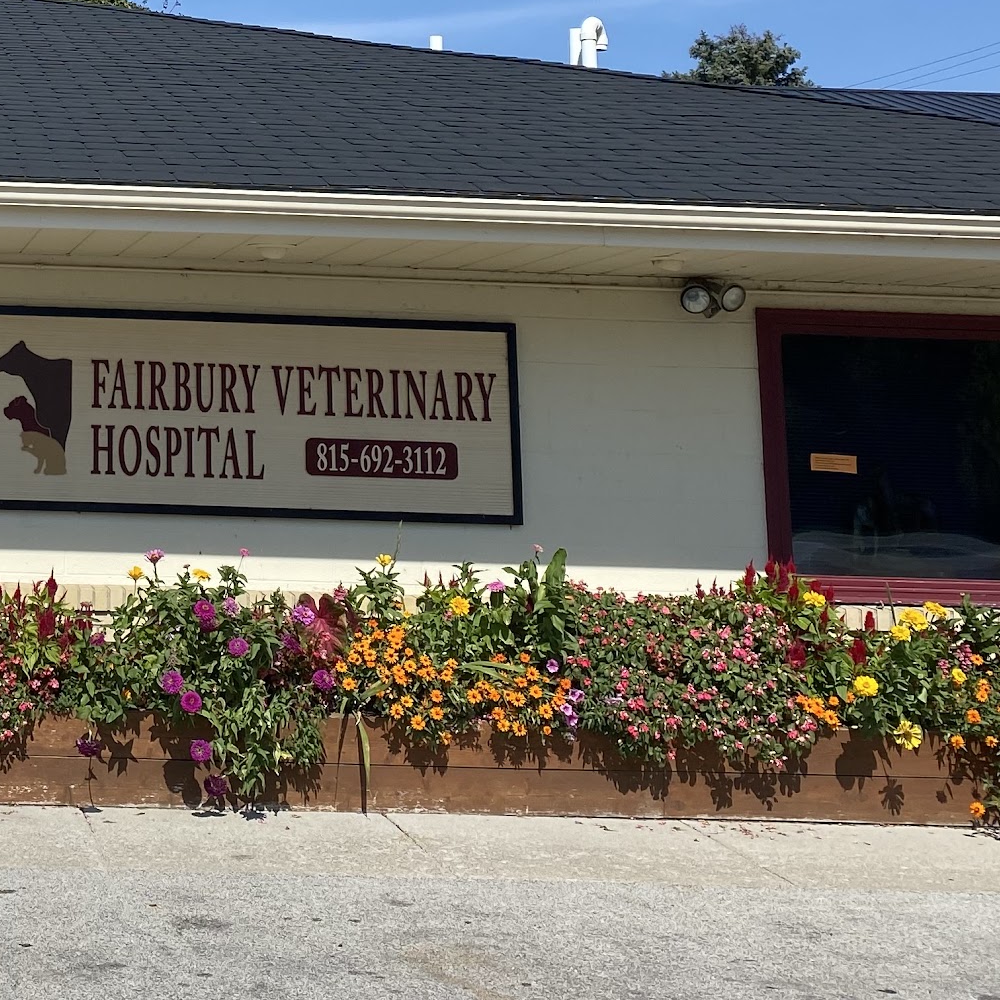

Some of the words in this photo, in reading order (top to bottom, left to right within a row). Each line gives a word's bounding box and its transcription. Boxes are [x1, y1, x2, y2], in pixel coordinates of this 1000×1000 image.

[91, 358, 261, 413] FAIRBURY
[271, 364, 497, 421] VETERINARY
[90, 424, 265, 480] HOSPITAL
[316, 442, 447, 475] 815-692-3112
